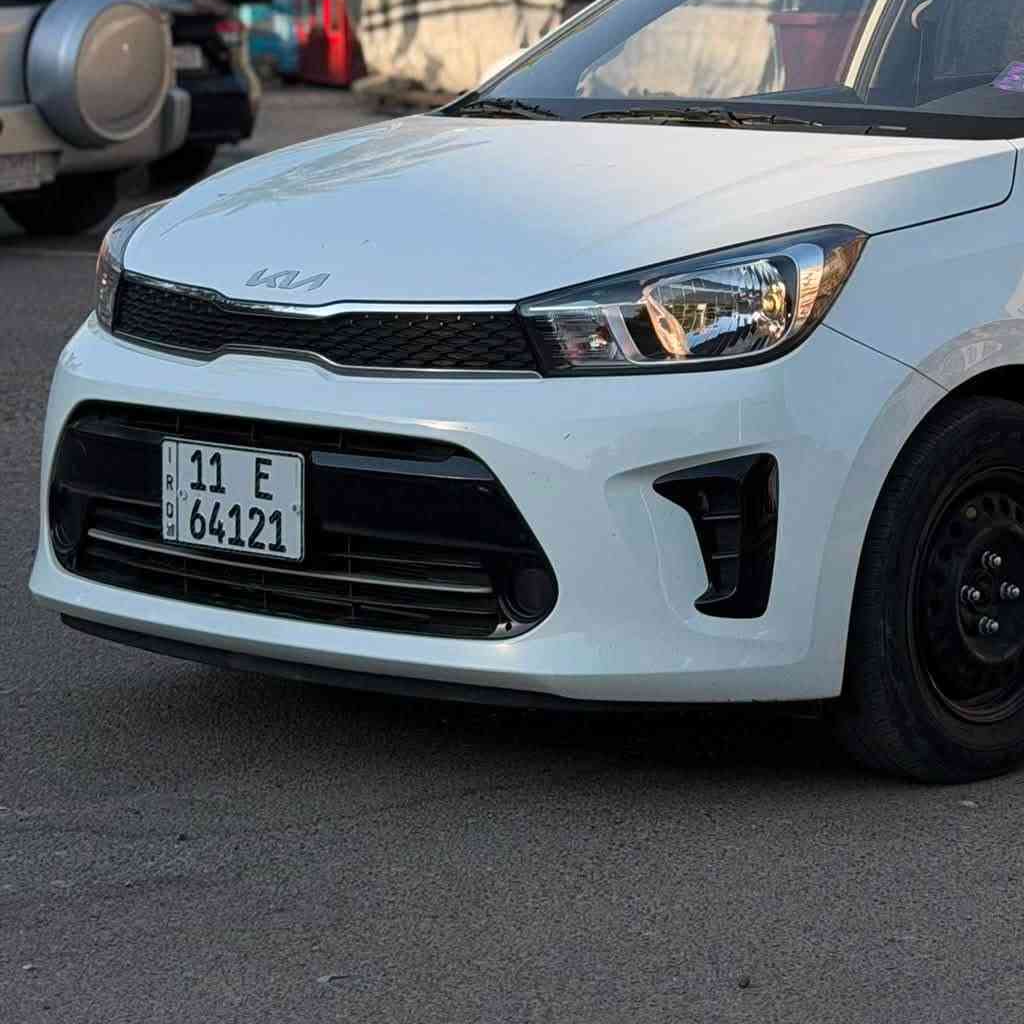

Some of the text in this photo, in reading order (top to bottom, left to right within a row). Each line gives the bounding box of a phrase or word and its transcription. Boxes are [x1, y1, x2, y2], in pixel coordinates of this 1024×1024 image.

[245, 268, 331, 291] KIA
[190, 450, 273, 500] 11 E
[190, 499, 287, 553] 64121
